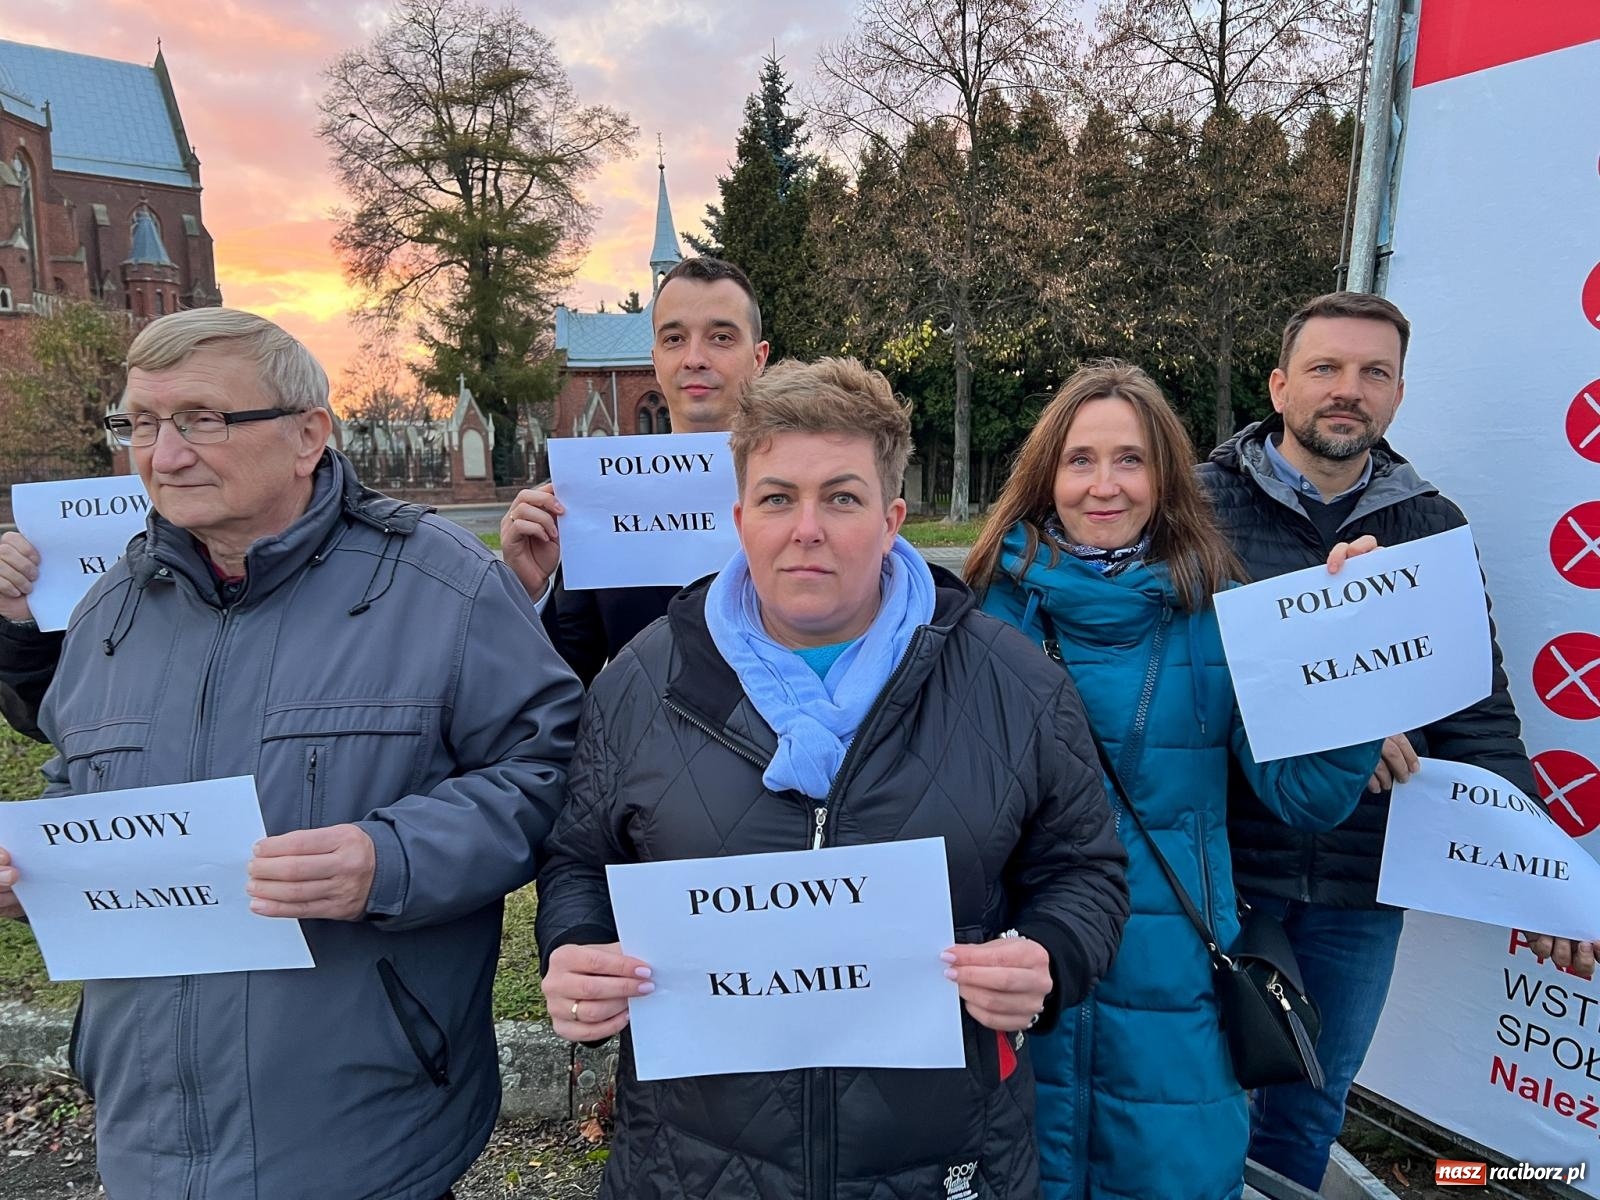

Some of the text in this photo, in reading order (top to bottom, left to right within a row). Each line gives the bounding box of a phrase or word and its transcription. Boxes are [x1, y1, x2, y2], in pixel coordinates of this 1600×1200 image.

[600, 454, 714, 476] POLOWY
[613, 512, 716, 533] KŁAMIE
[78, 556, 121, 574] KŁ
[1277, 564, 1421, 620] POLOWY
[1300, 635, 1434, 686] KŁAMIE
[41, 811, 192, 845] POLOWY
[1447, 840, 1571, 881] KŁAMIE
[83, 885, 219, 910] KŁAMIE
[688, 876, 869, 915] POLOWY
[706, 964, 872, 996] KŁAMIE
[1503, 967, 1600, 1032] WST
[1490, 1055, 1600, 1129] Należ
